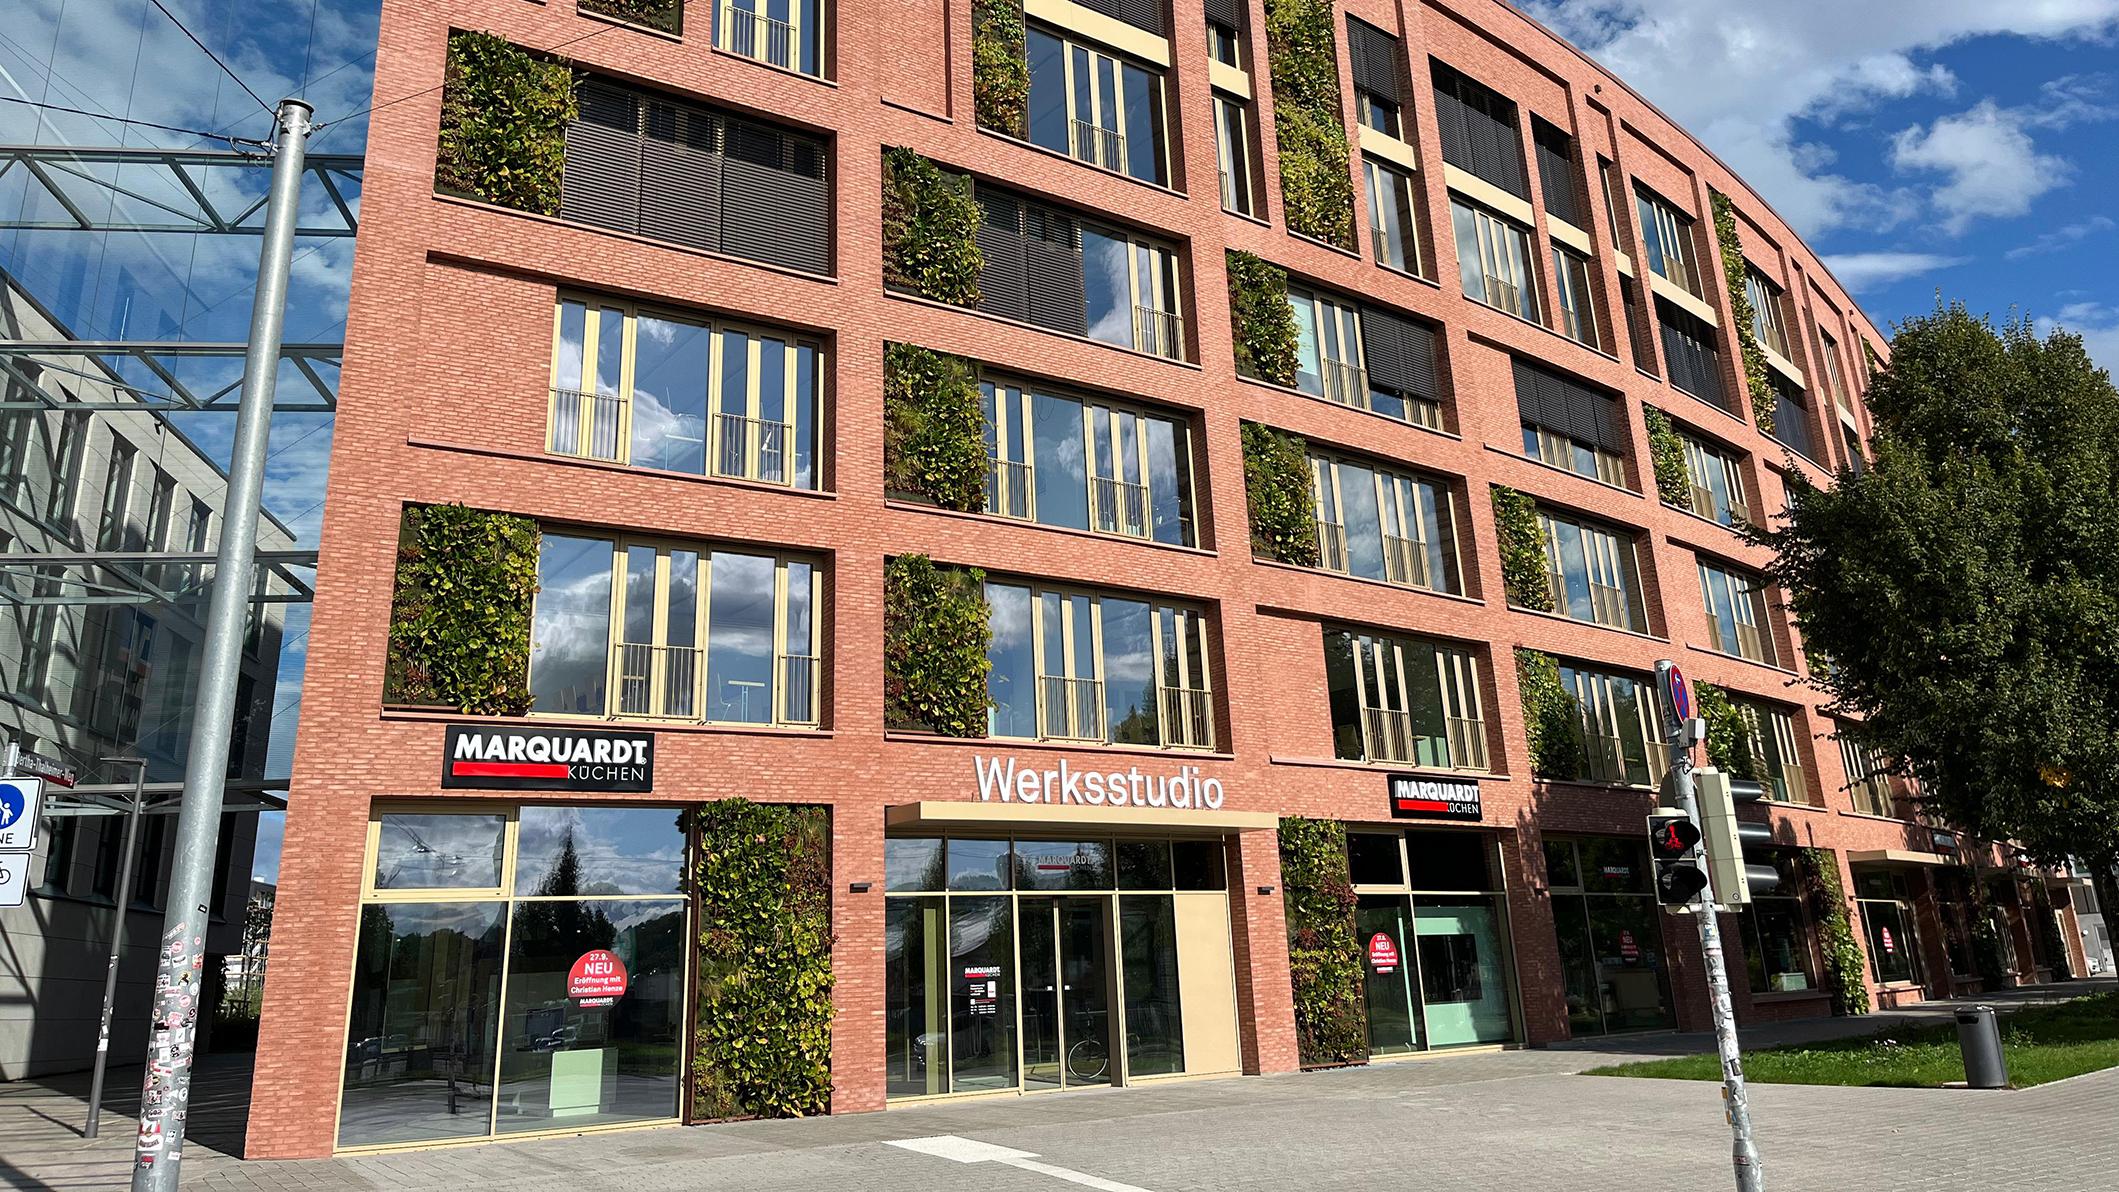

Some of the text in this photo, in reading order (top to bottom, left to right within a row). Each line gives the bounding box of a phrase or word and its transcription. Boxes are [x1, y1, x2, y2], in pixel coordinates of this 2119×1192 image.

[453, 733, 648, 764] MARQUARDT
[567, 765, 645, 781] KÜCHEN
[973, 754, 1225, 810] Werksstudio
[1394, 780, 1479, 803] MARQUARDT
[1375, 941, 1390, 951] NEU
[590, 953, 609, 961] 27.9.
[584, 962, 613, 975] NEU
[574, 975, 622, 985] Eröffnung mit
[571, 986, 602, 994] Christian
